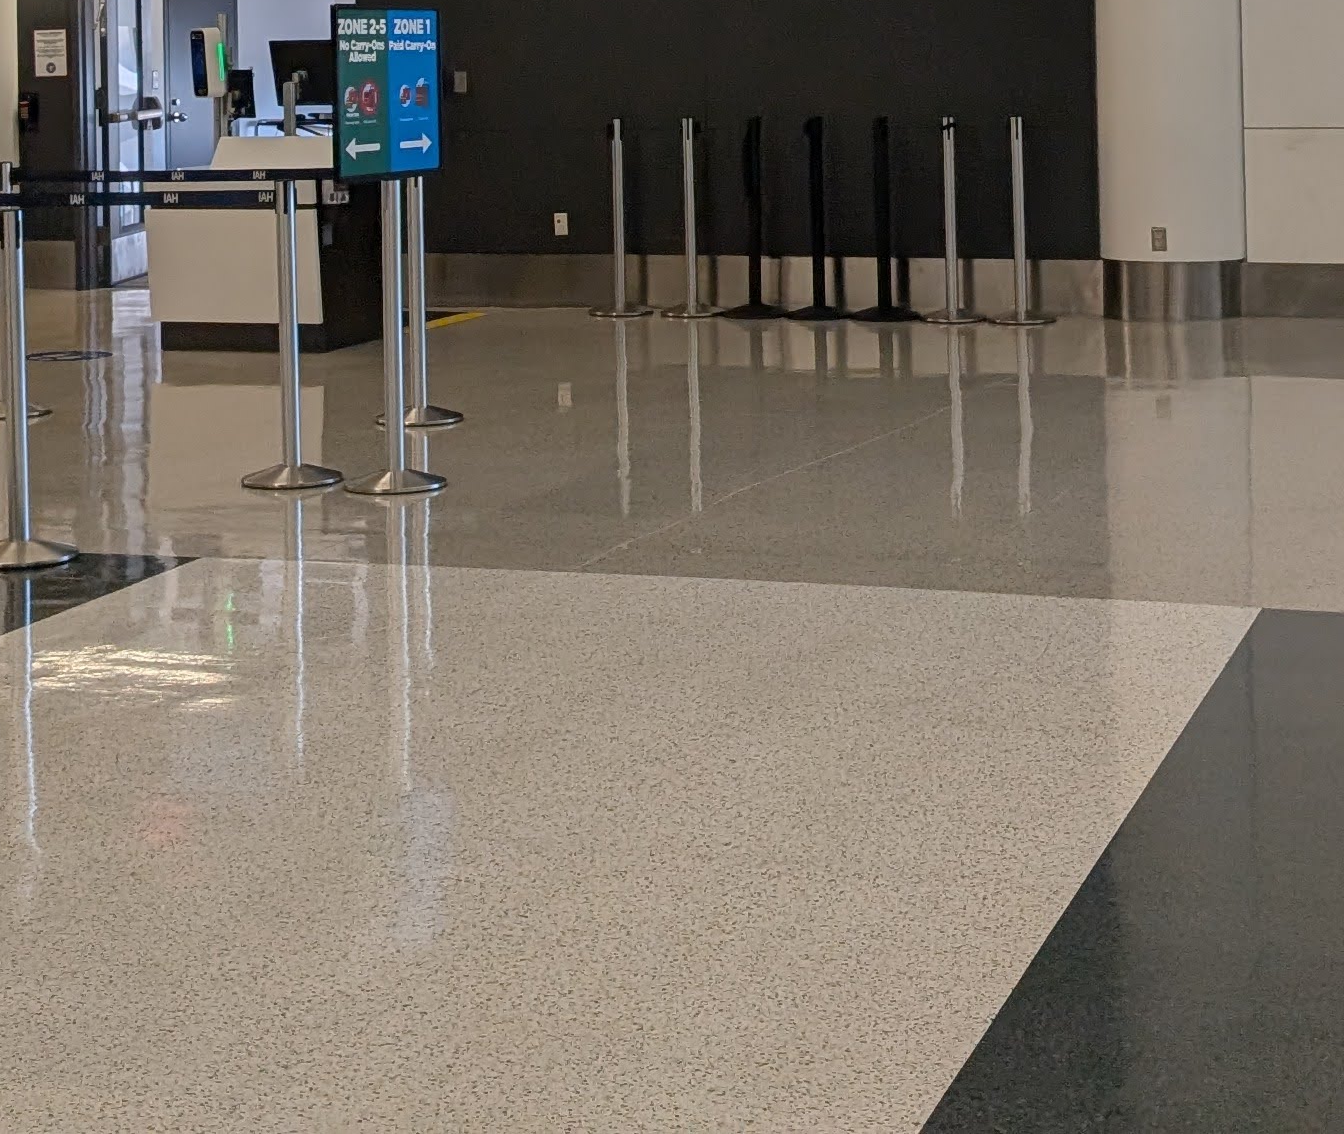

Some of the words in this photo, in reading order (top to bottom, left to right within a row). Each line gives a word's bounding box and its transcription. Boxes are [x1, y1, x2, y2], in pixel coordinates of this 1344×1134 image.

[337, 18, 368, 35] ZONE
[369, 18, 387, 35] 2-5
[393, 18, 424, 35] ZONE
[425, 18, 431, 35] 1
[339, 40, 350, 51] No
[351, 39, 386, 53] Carry-Ons
[388, 40, 404, 51] Paid
[405, 40, 436, 53] Carry-On
[348, 51, 377, 63] Allowed
[252, 171, 266, 180] IAH
[70, 194, 85, 205] IAH
[163, 193, 179, 203] IAH
[258, 192, 274, 203] IAH
